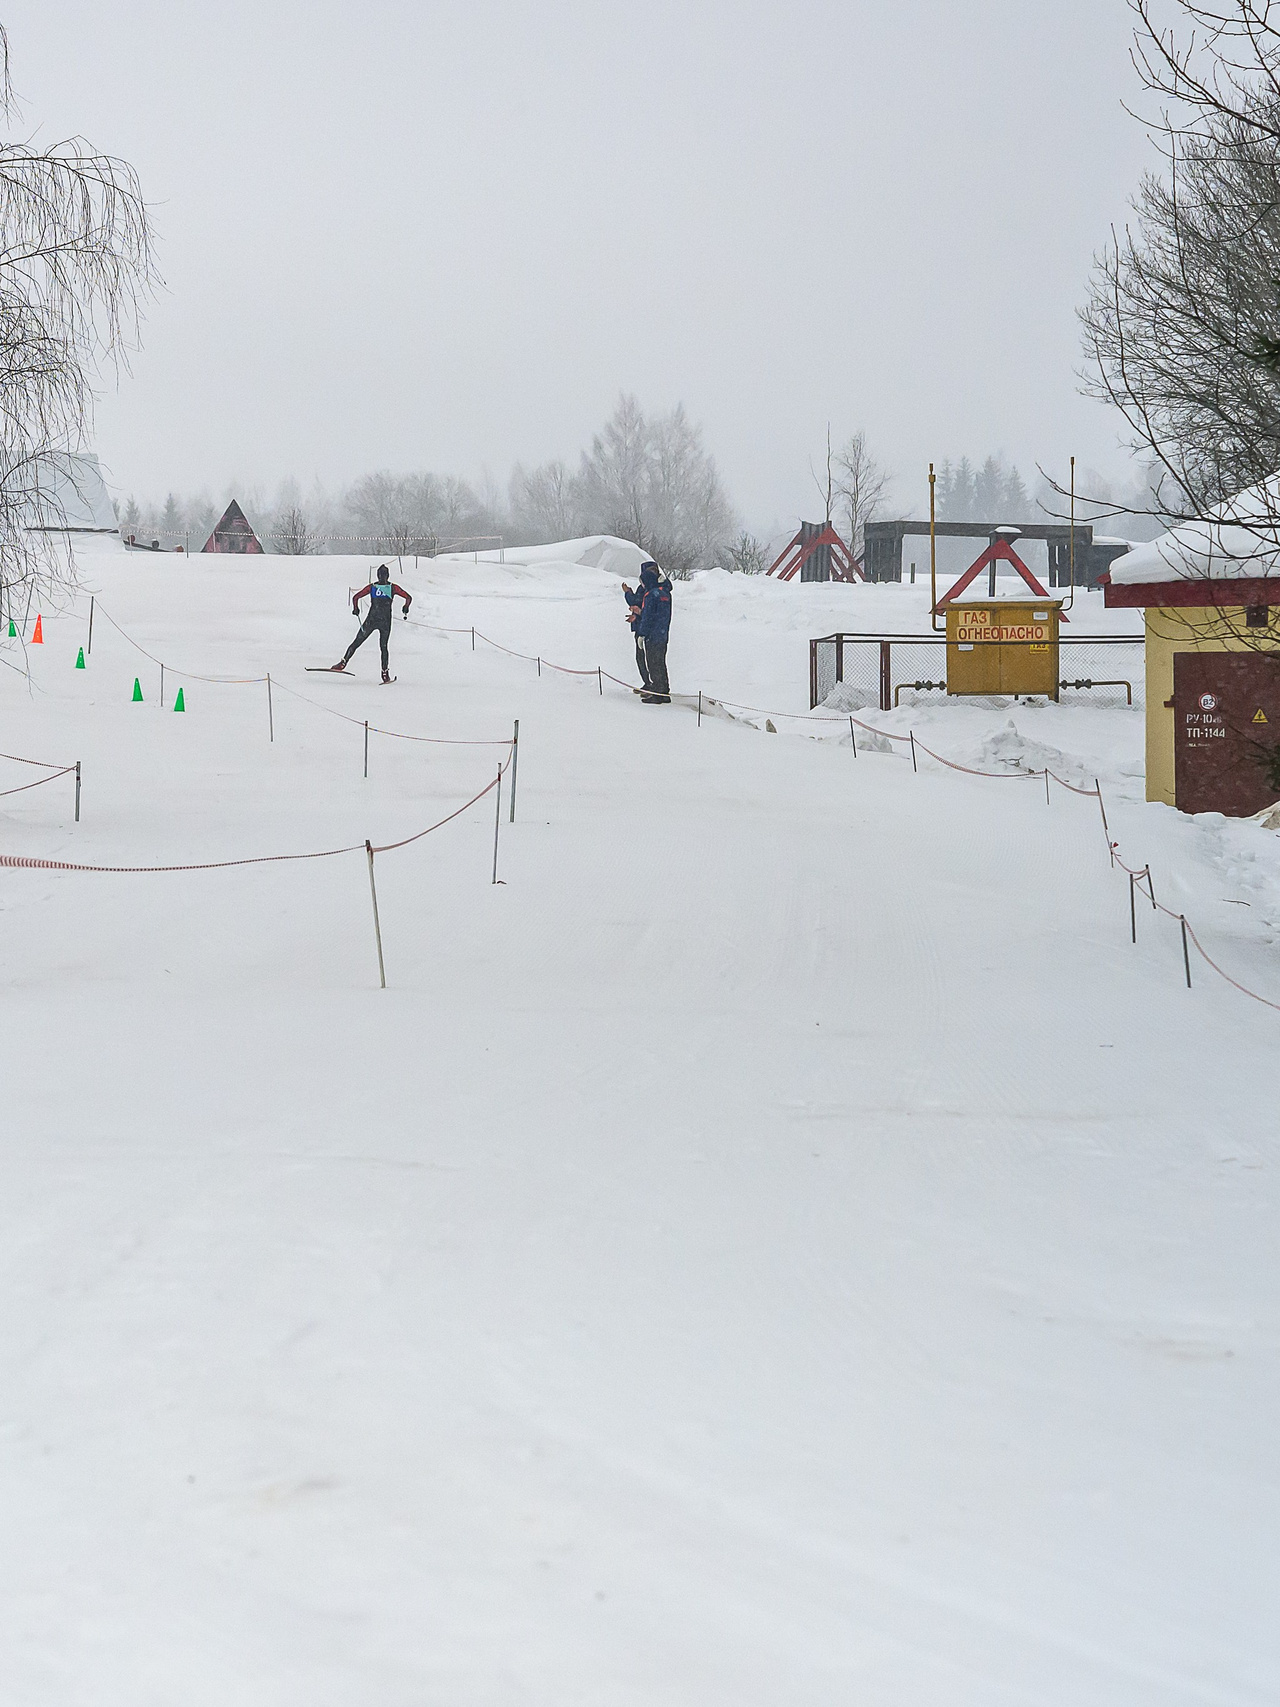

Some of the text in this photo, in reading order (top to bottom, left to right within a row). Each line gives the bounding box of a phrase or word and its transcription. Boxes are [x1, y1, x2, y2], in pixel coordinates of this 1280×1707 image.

[964, 611, 987, 624] ГАЗ
[958, 627, 1043, 639] ОГНЕОПАСНО
[1186, 727, 1226, 738] ТП-1144
